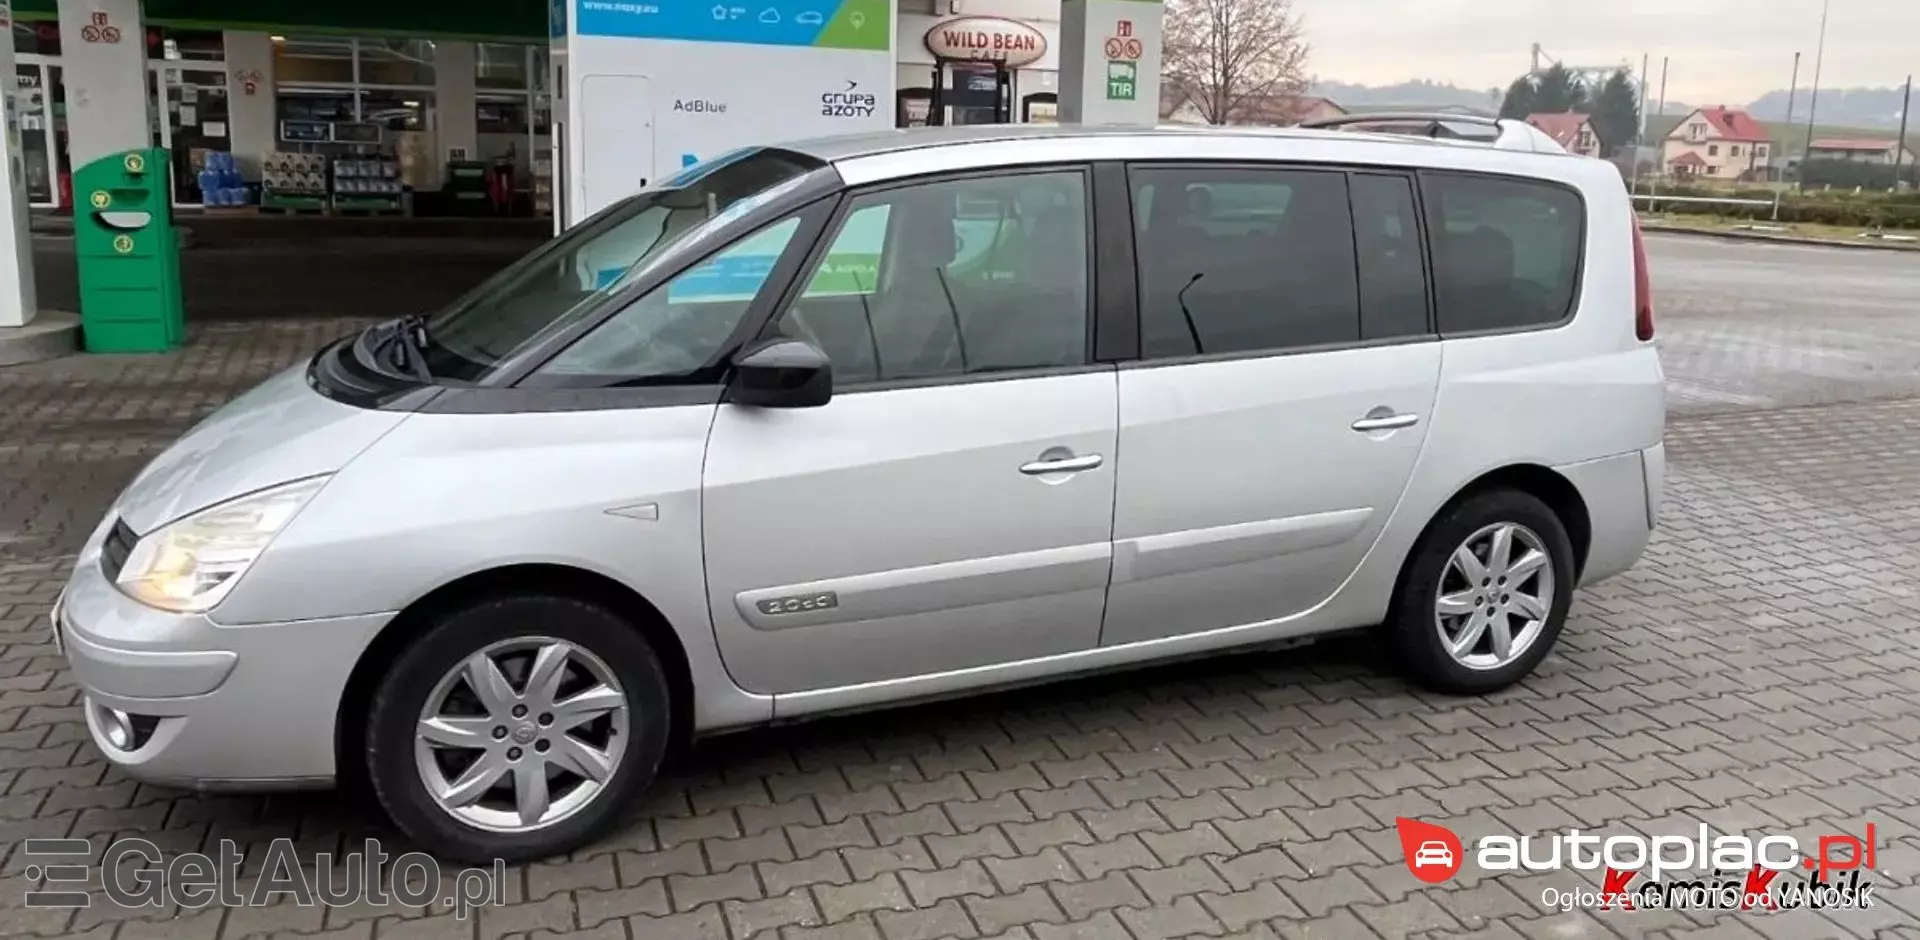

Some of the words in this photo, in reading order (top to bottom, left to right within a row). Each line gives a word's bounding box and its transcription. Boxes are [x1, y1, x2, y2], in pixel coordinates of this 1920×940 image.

[943, 31, 988, 48] WILD
[993, 33, 1035, 51] BEAN
[1110, 82, 1133, 97] TIR
[673, 99, 727, 113] AdBlue
